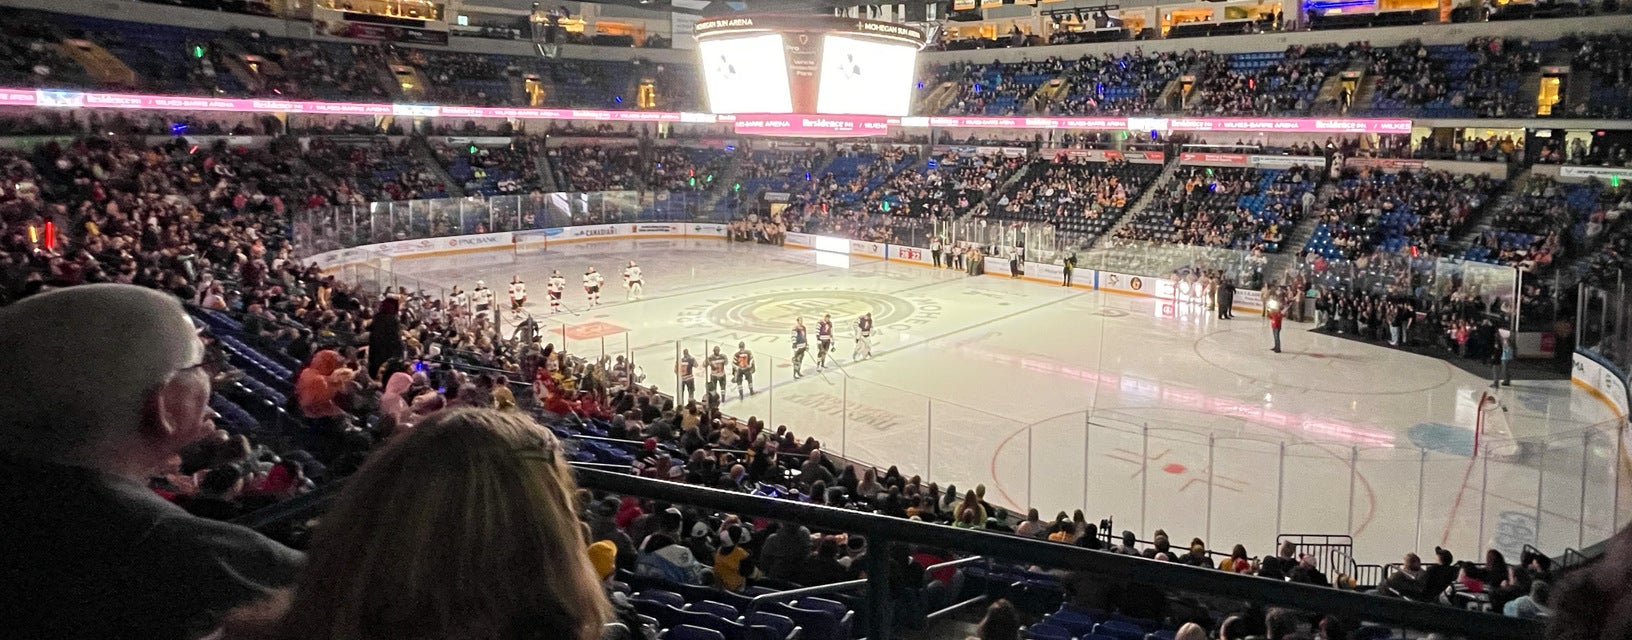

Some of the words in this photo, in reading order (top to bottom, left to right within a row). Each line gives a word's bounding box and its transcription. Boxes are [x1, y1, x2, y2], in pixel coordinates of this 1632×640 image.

[729, 18, 753, 26] ARENA
[864, 22, 897, 33] MOHEGAN
[897, 27, 908, 35] SUN
[803, 118, 843, 127] Residence
